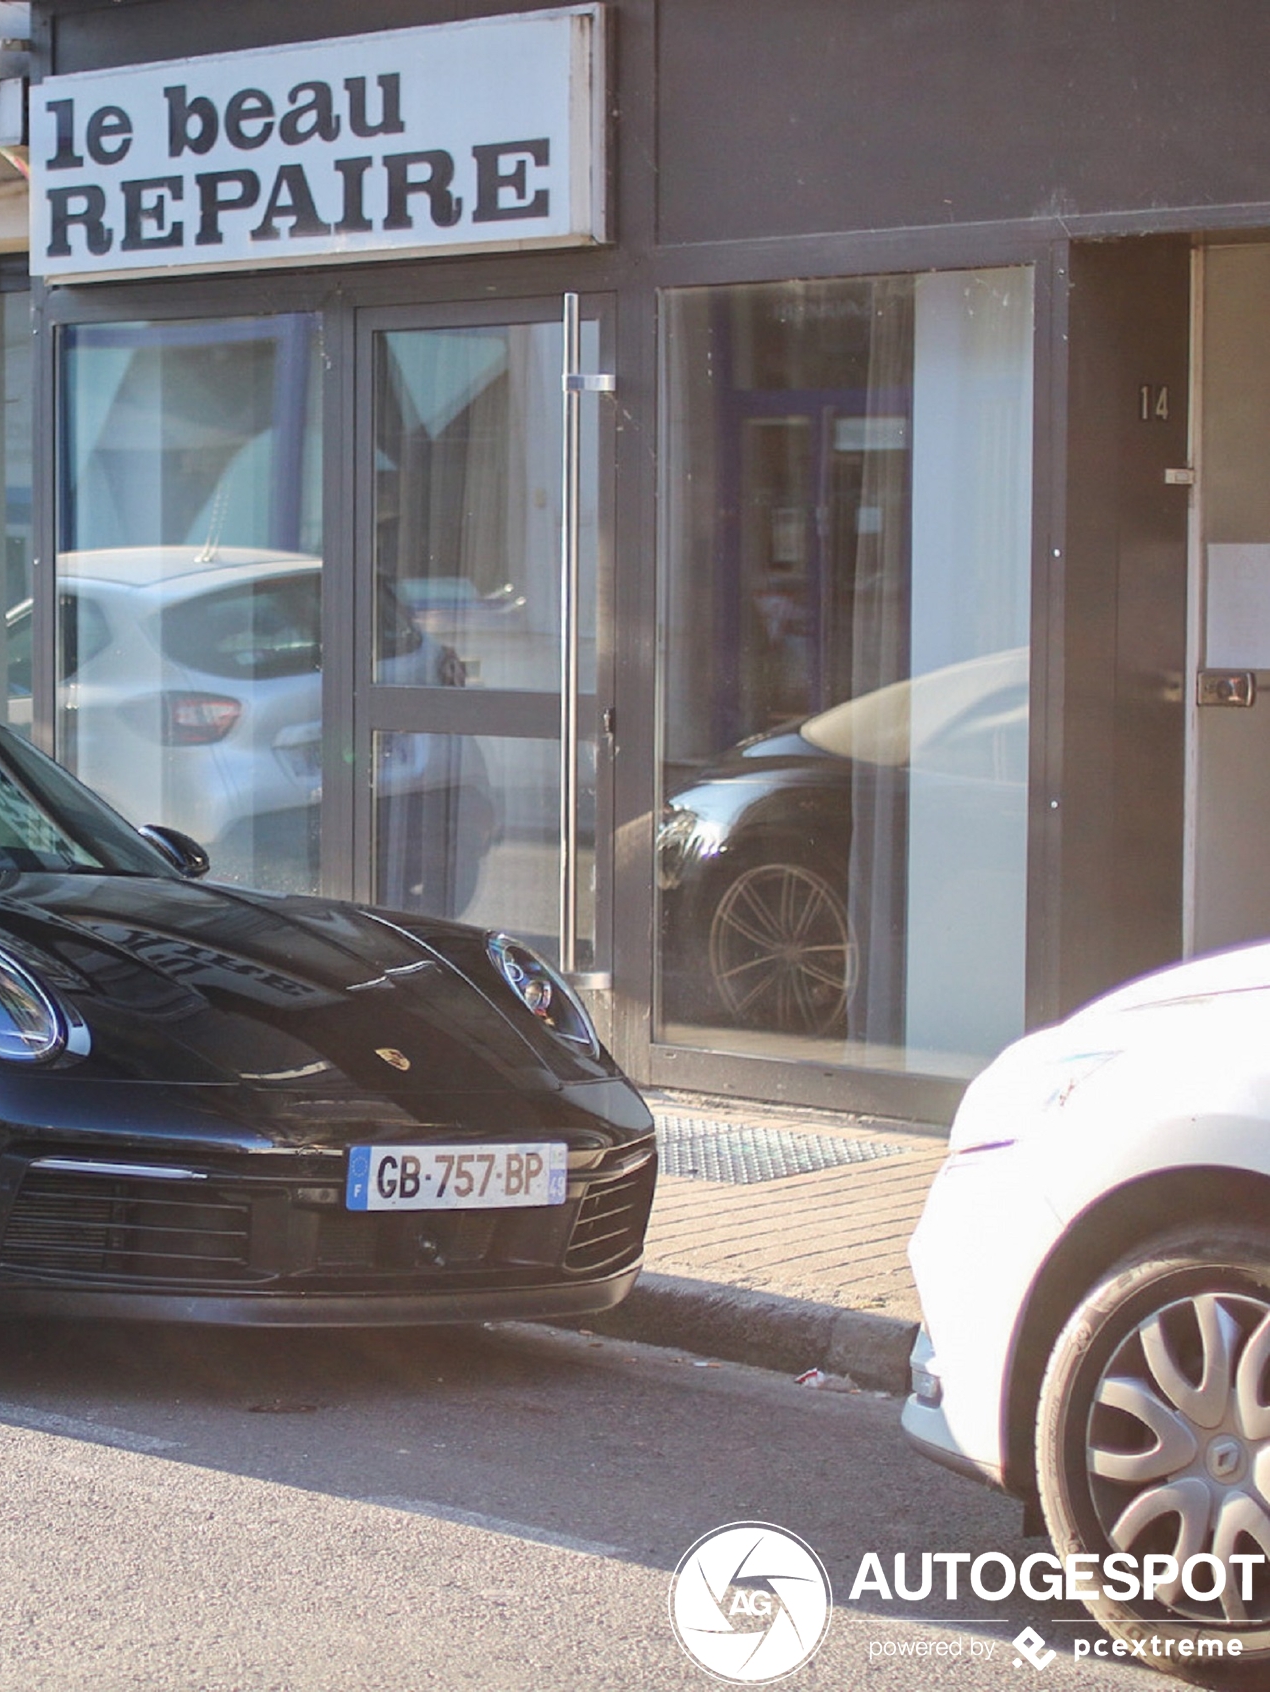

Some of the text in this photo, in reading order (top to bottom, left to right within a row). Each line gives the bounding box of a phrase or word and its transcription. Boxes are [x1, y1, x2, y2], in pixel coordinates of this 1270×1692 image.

[45, 72, 406, 171] le beau
[46, 137, 551, 258] REPAIRE
[1140, 385, 1169, 420] 14
[353, 1152, 566, 1199] F GB-757-BP 49
